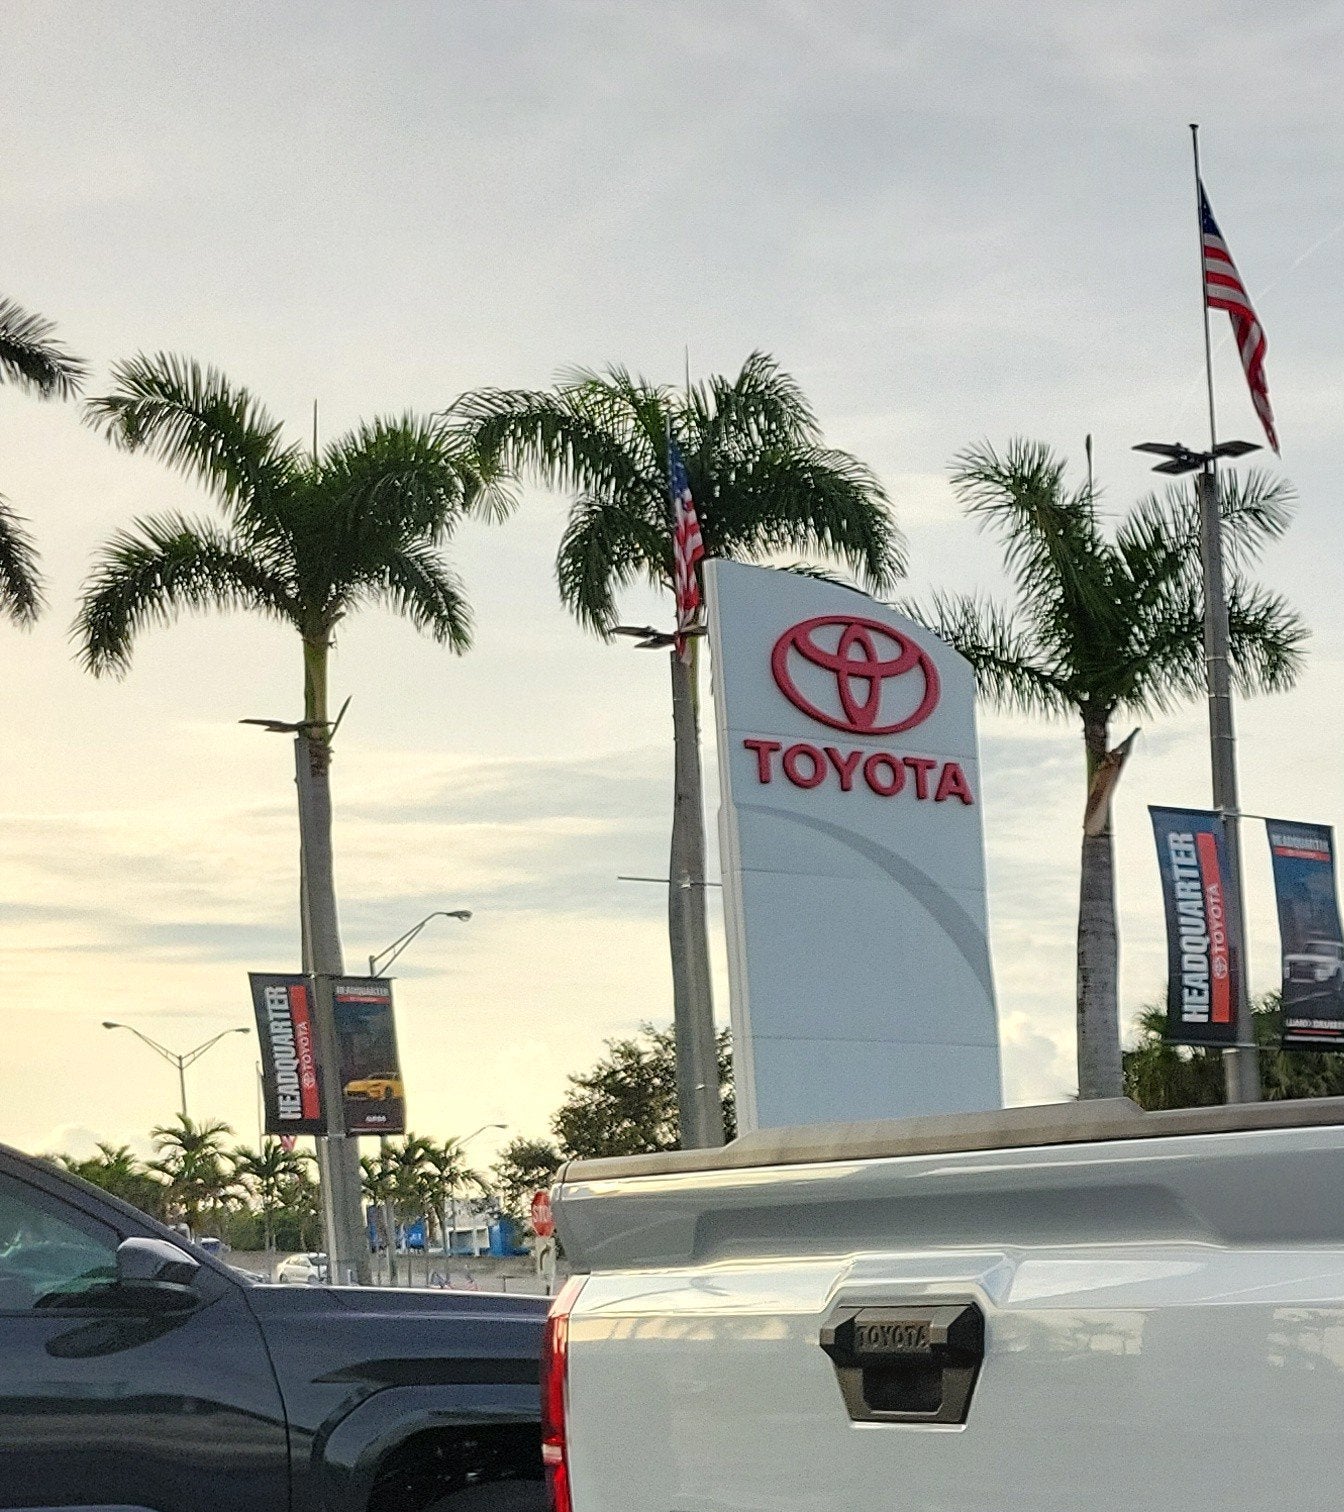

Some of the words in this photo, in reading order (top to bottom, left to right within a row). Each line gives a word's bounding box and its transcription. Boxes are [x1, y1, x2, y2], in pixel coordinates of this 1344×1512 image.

[743, 739, 974, 806] TOYOTA
[1167, 831, 1210, 1023] HEADQUARTER
[1206, 882, 1228, 954] TOYOTA
[264, 986, 302, 1120] HEADQUARTER
[295, 1021, 315, 1073] TOYOTA
[856, 1324, 931, 1349] TOYOTA
